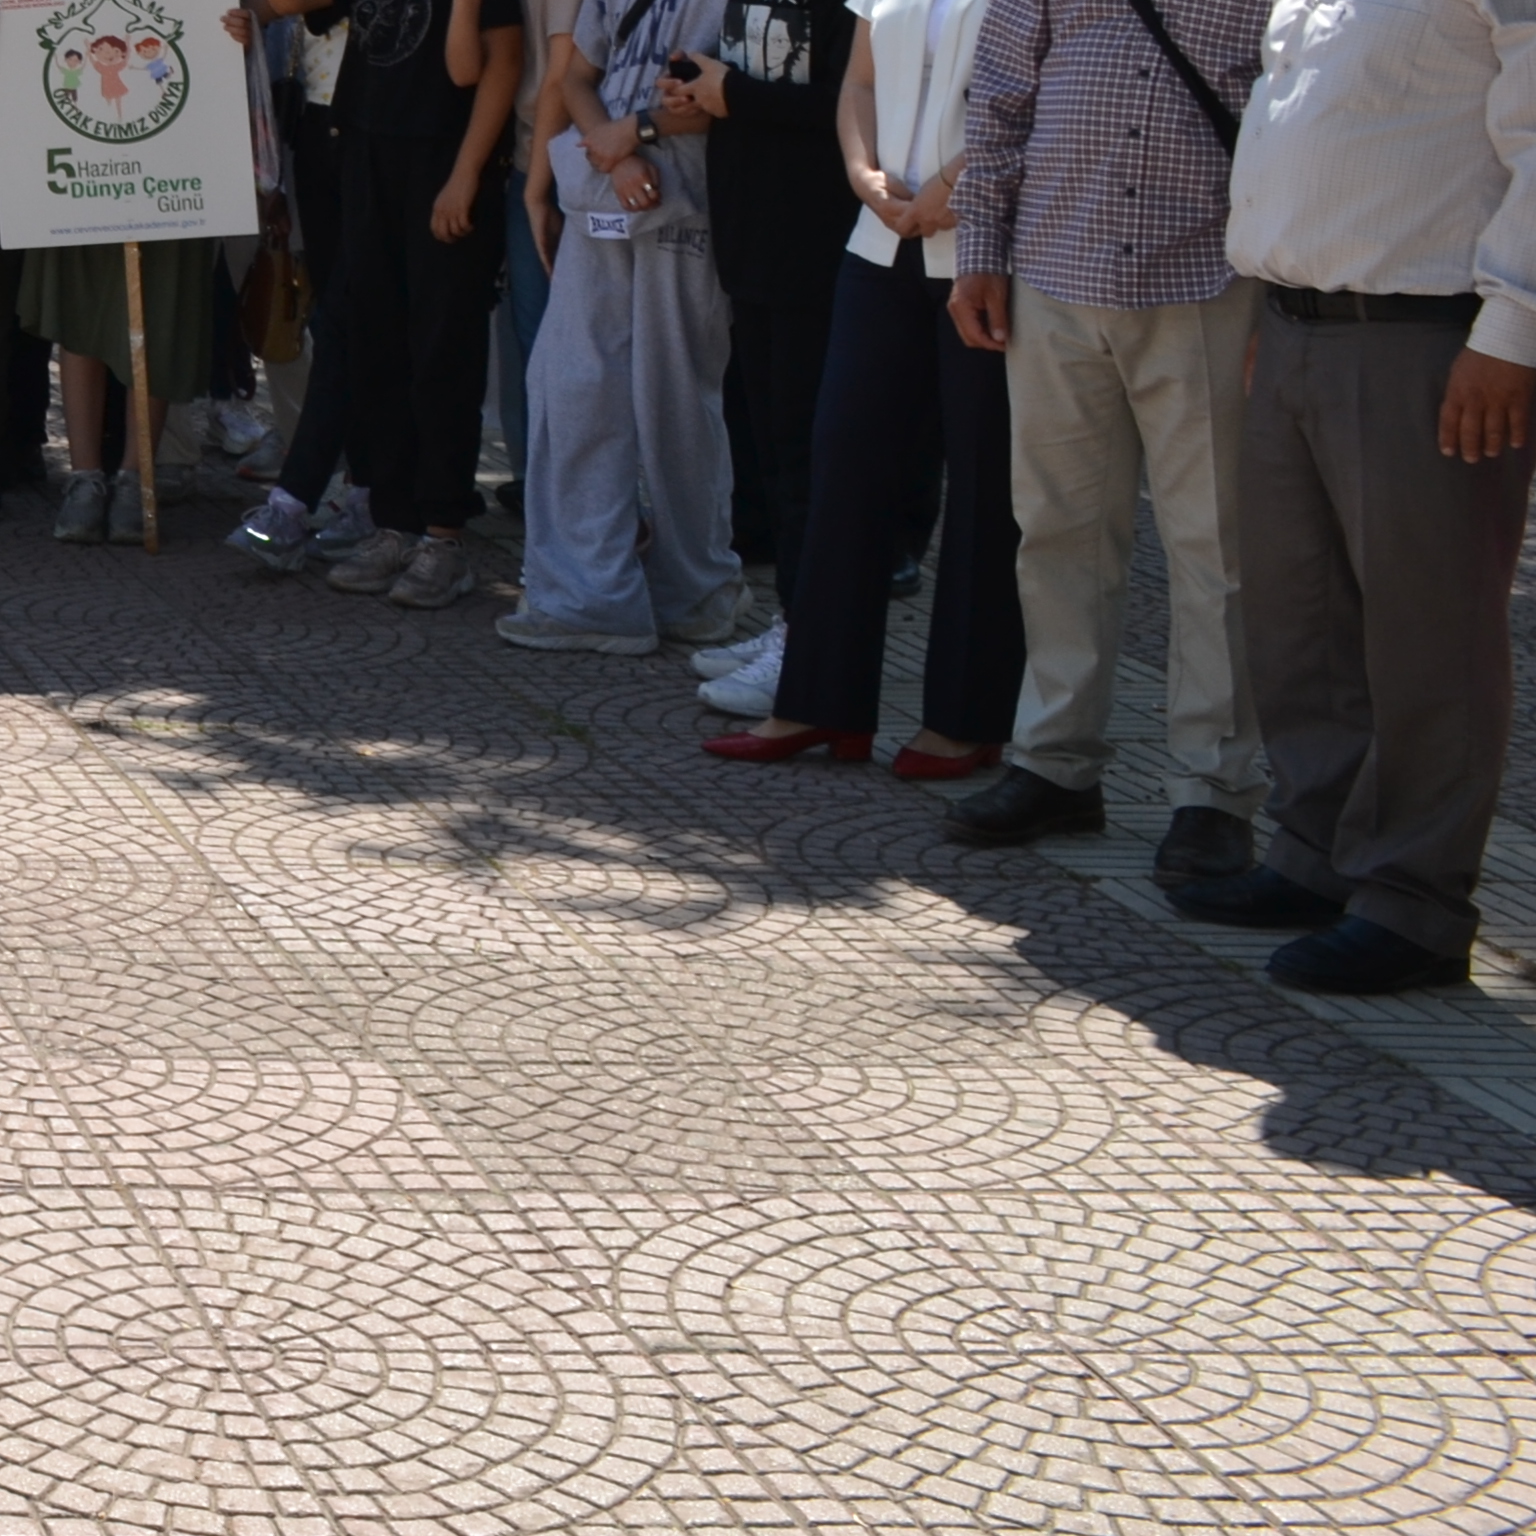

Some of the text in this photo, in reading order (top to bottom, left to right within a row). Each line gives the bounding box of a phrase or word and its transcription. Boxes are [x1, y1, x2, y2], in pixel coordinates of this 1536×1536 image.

[53, 81, 184, 139] ORTAK EVİMİZ DÜNYA
[47, 148, 142, 195] 5 Haziran
[71, 176, 202, 200] Dünya Çevre
[157, 194, 204, 213] Günü
